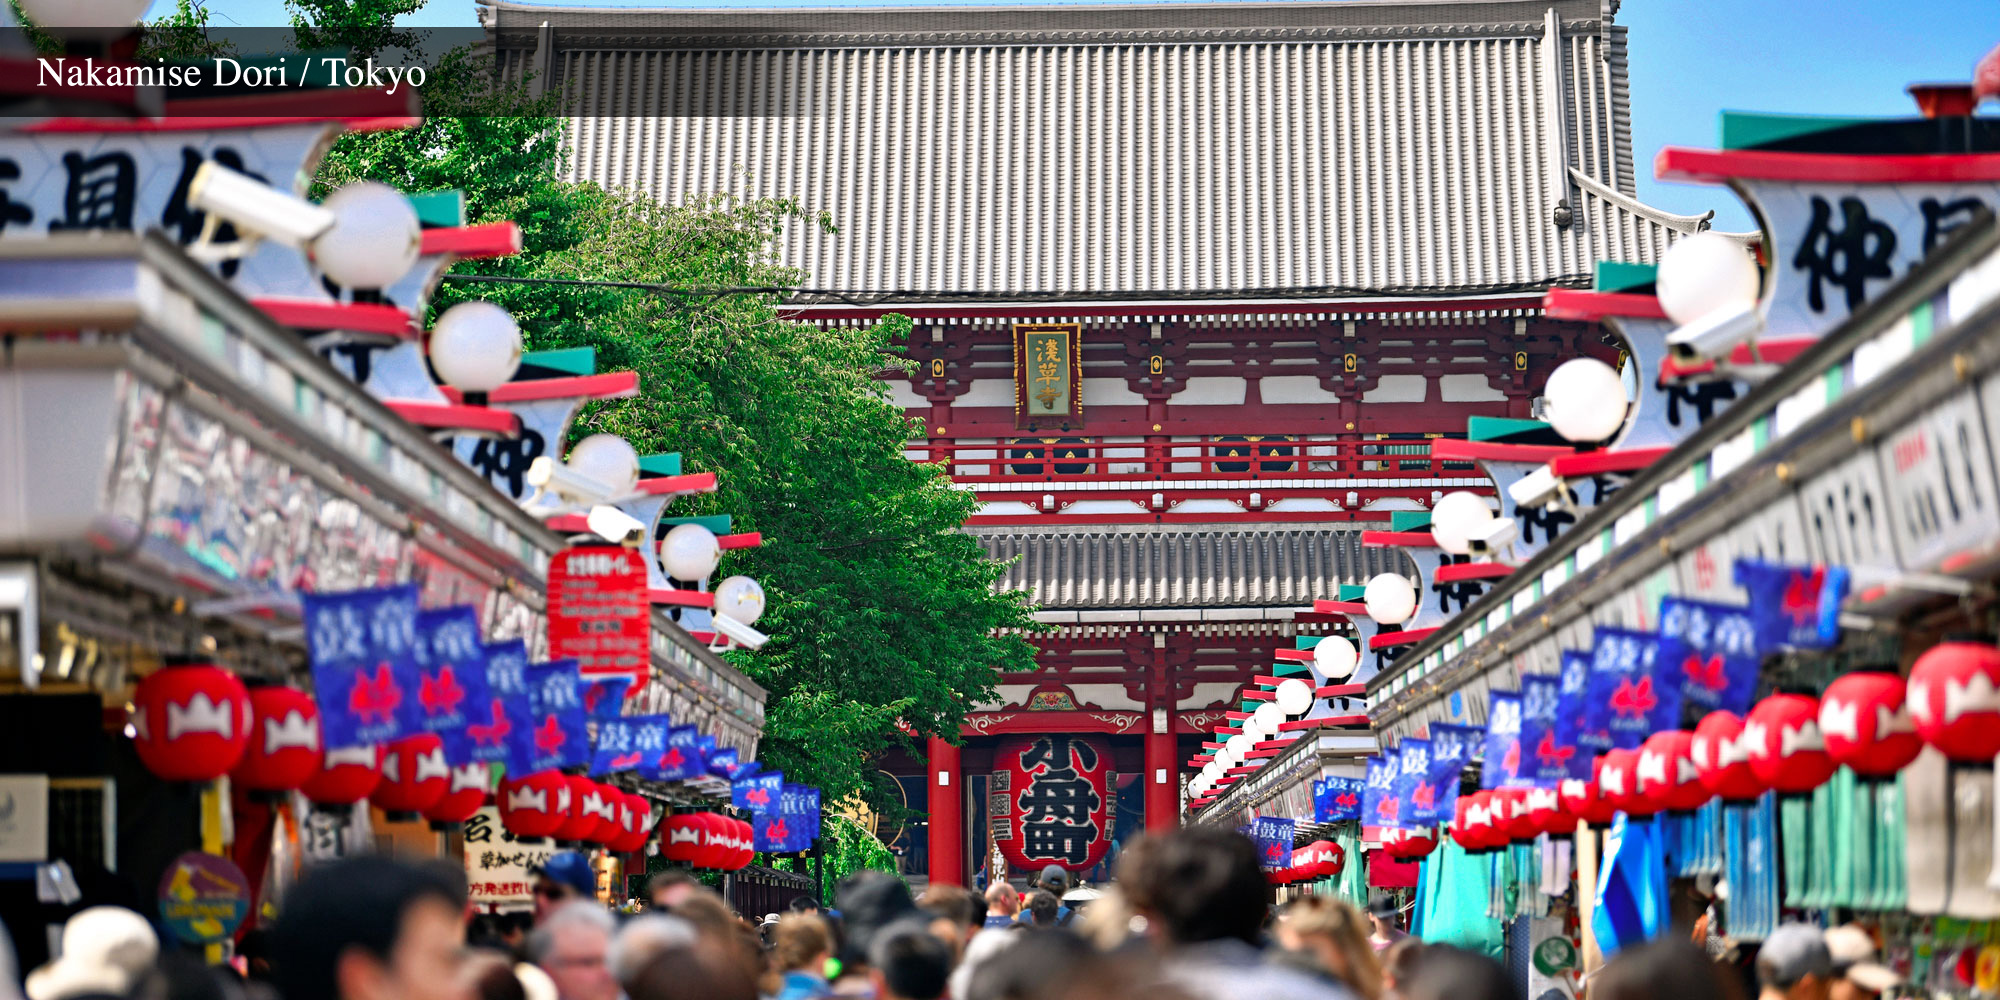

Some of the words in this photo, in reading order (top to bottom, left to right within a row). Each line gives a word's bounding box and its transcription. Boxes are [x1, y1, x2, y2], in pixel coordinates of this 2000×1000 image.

[1018, 737, 1101, 865] 小舟町
[1260, 823, 1292, 841] 鼓童
